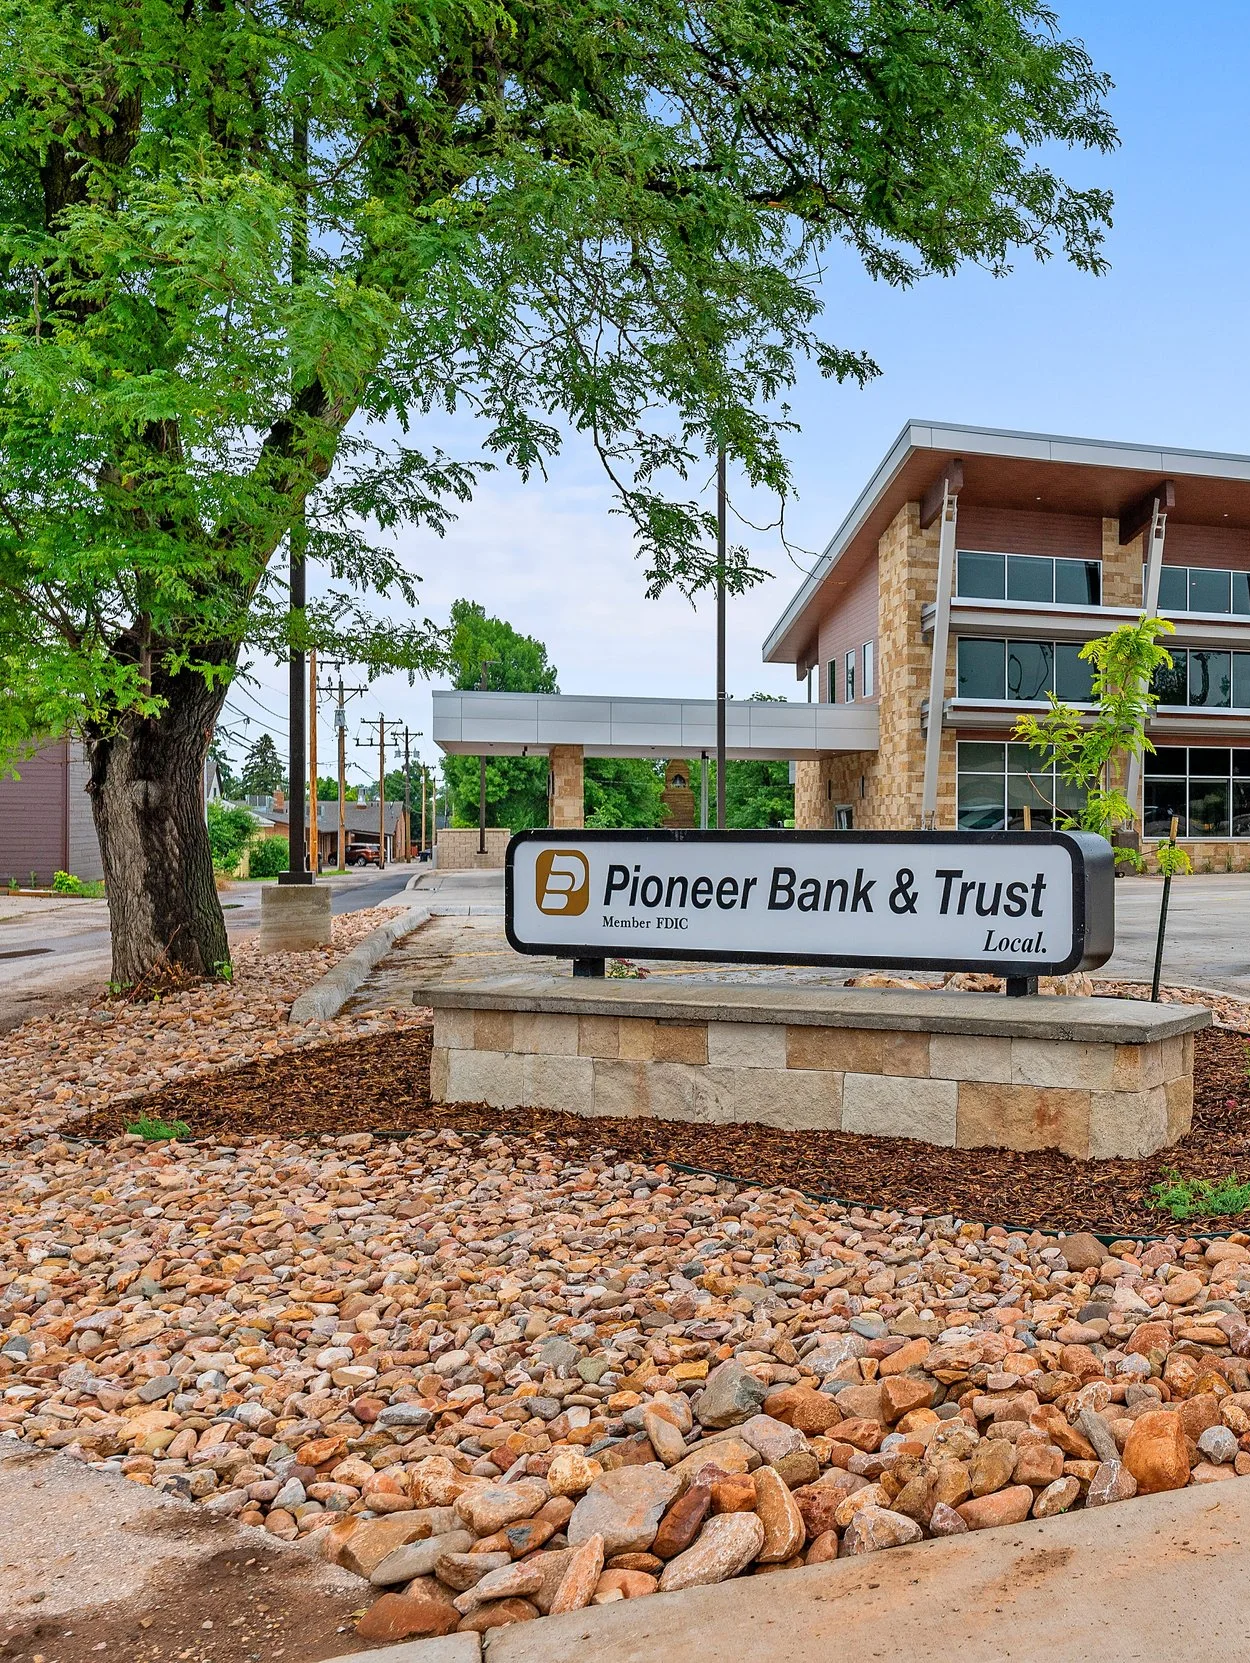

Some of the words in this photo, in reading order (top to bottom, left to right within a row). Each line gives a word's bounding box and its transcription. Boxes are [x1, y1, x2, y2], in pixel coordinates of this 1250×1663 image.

[603, 864, 758, 910] Pioneer
[767, 867, 877, 912] Bank
[889, 867, 919, 914] &
[935, 869, 1047, 918] Trust
[602, 915, 651, 929] Member
[656, 917, 689, 930] FDIC
[982, 929, 1047, 954] Local.
